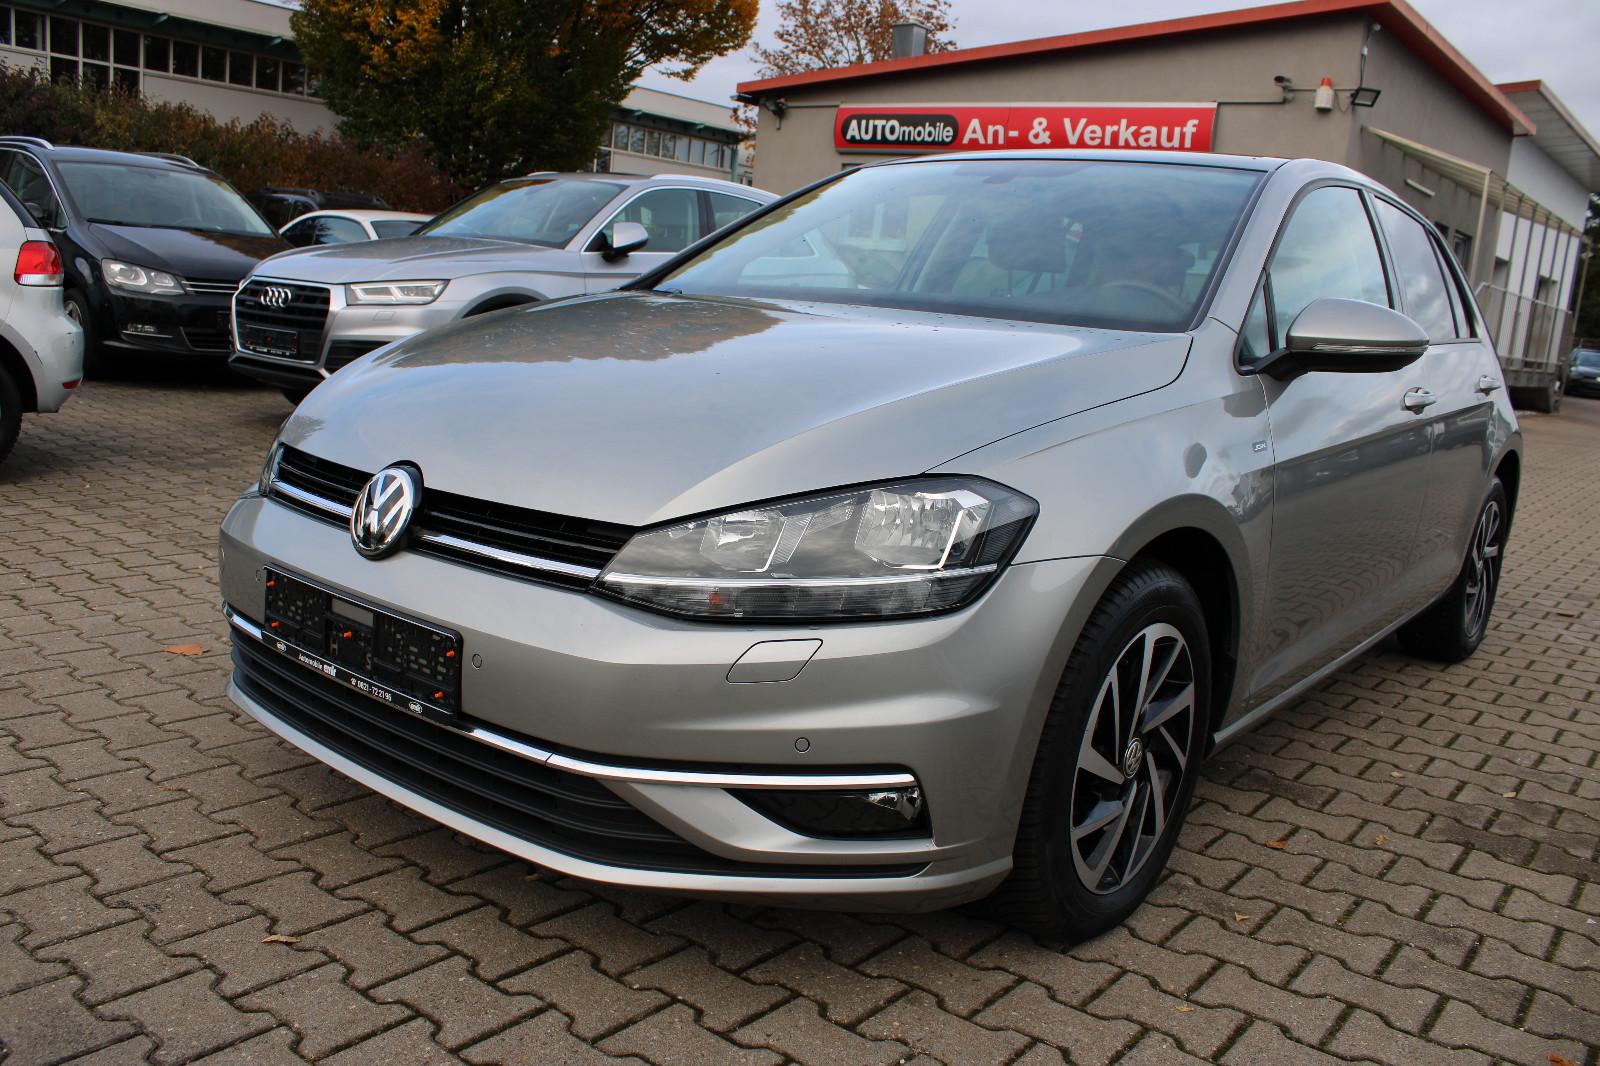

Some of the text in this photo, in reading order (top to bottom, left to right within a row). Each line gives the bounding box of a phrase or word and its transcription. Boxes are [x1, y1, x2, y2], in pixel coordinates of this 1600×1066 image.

[845, 116, 1200, 148] AUTOmobile An- & Verkauf
